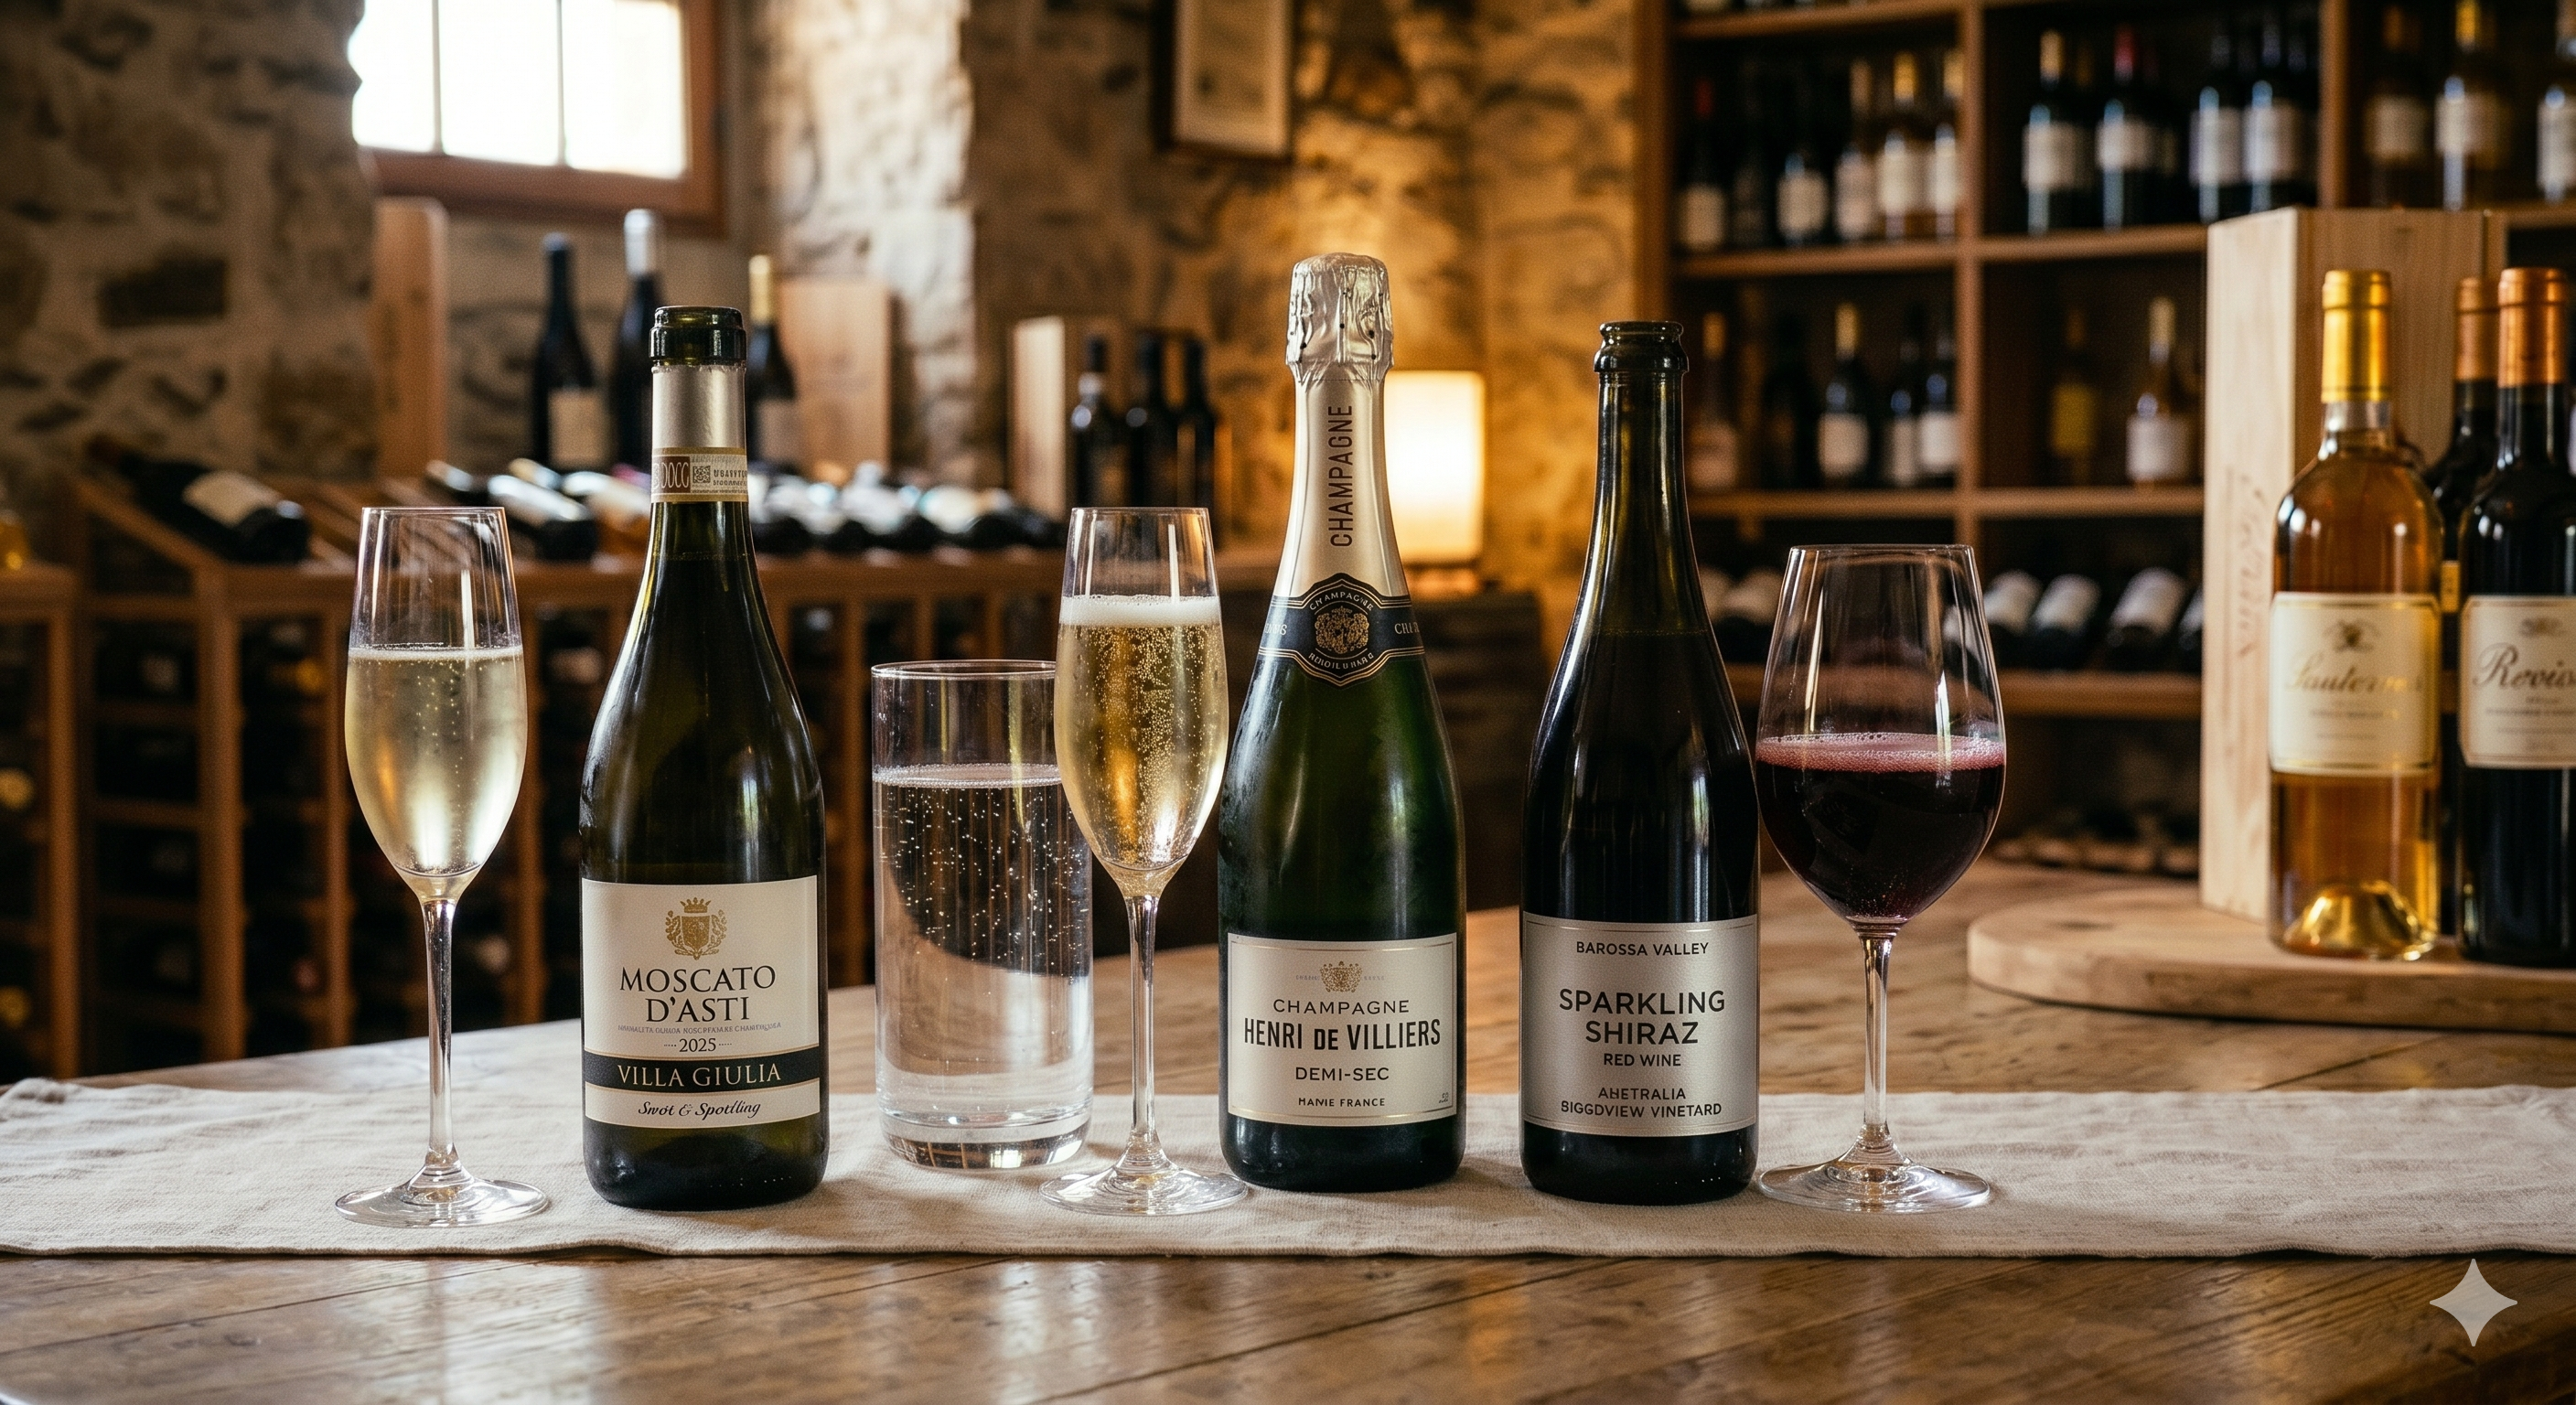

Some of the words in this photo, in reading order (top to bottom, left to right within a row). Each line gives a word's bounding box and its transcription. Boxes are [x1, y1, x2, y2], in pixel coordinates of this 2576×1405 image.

[1327, 405, 1354, 547] CHAMPAGNE
[1576, 940, 1648, 956] BAROSSA
[1652, 941, 1709, 956] VALLEY
[619, 965, 776, 993] MOSCATO
[645, 996, 749, 1023] D'ASTI
[1272, 998, 1410, 1015] CHAMPAGNE
[1559, 988, 1725, 1015] SPARKLING
[1244, 1017, 1303, 1049] HENRI
[1314, 1028, 1339, 1050] DE
[1347, 1018, 1441, 1050] VILLIERS
[1585, 1020, 1699, 1046] SHIRAZ
[679, 1037, 717, 1053] 2025
[1603, 1052, 1636, 1067] RED
[1639, 1054, 1681, 1067] WINE
[617, 1064, 684, 1087] VILLA
[692, 1063, 782, 1087] GIULIA
[1295, 1067, 1390, 1081] DEMI-SEC
[678, 1103, 692, 1117] &
[1339, 1098, 1385, 1108] FRANCE
[1650, 1102, 1723, 1118] VINETARD
